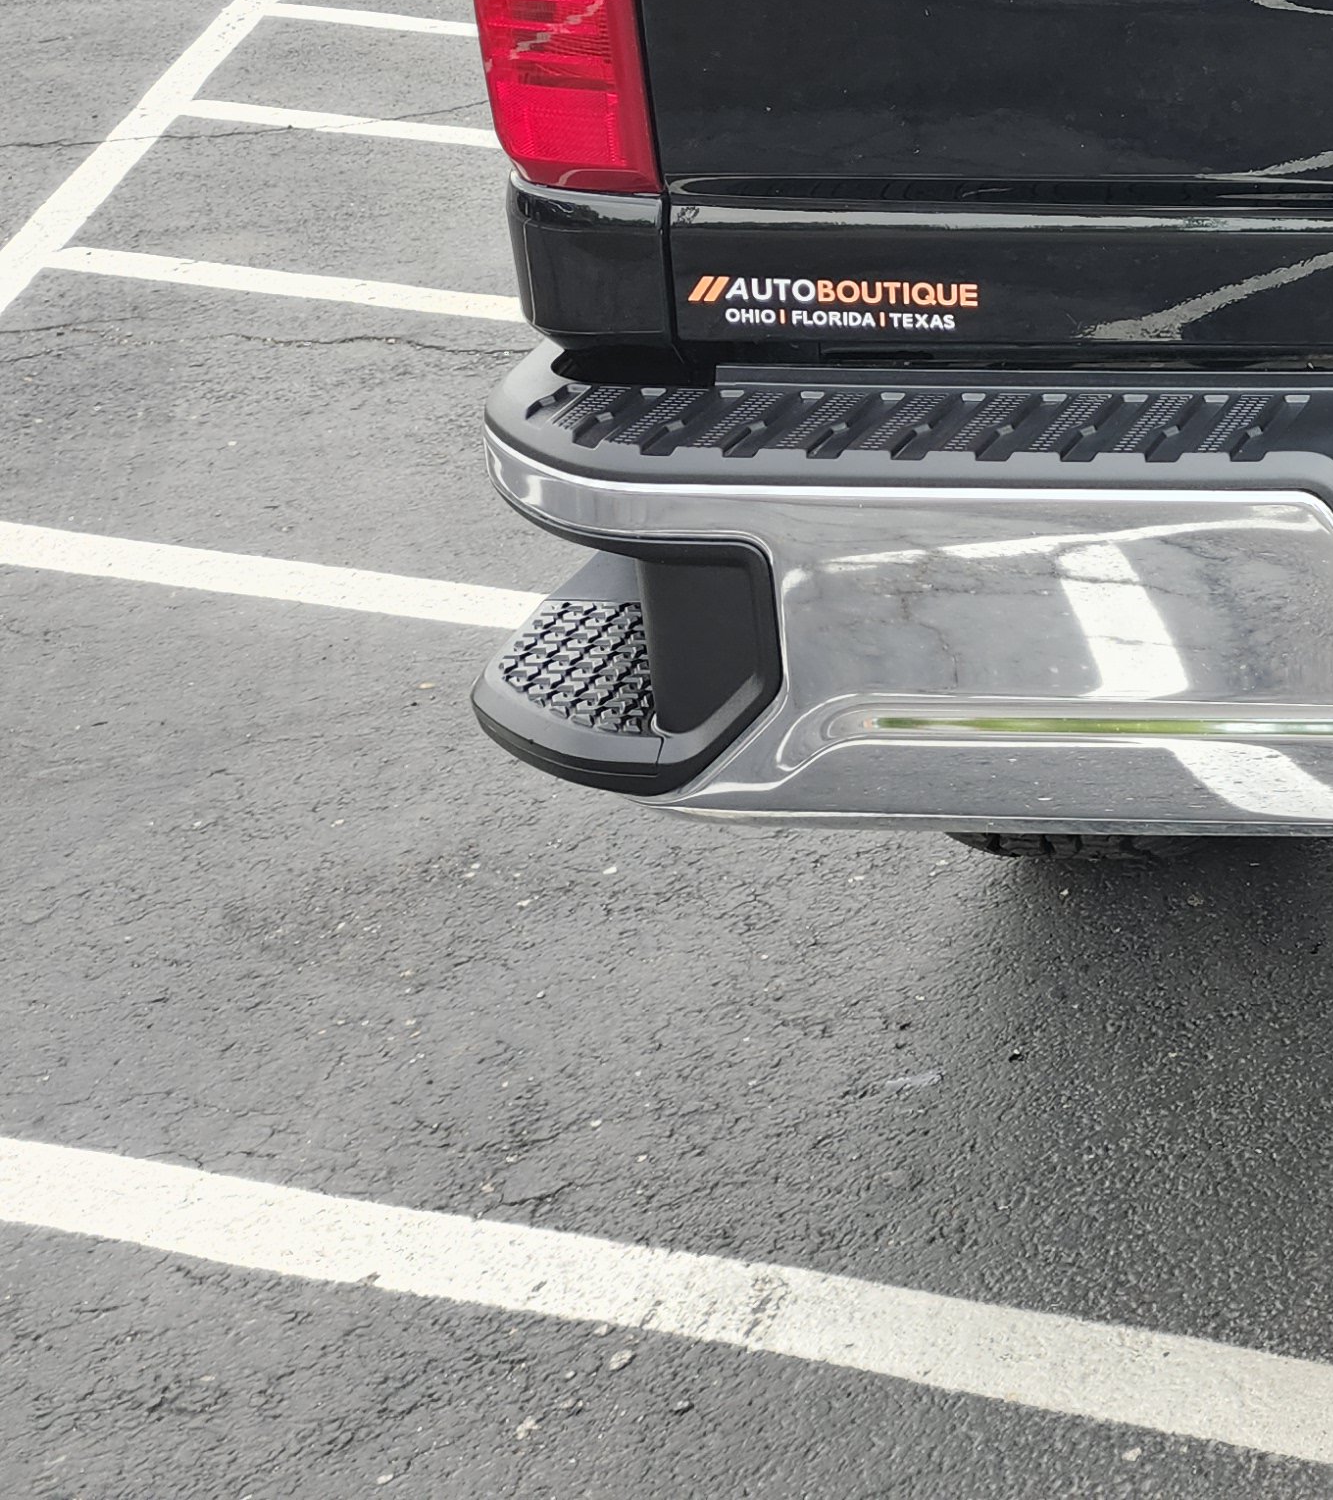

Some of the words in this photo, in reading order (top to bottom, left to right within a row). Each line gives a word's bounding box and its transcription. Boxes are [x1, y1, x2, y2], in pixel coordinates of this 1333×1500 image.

[724, 277, 979, 307] AUTOBOUTIQUE
[725, 308, 776, 324] OHIO
[791, 310, 876, 327] FLORIDA
[890, 312, 956, 330] TEXAS
